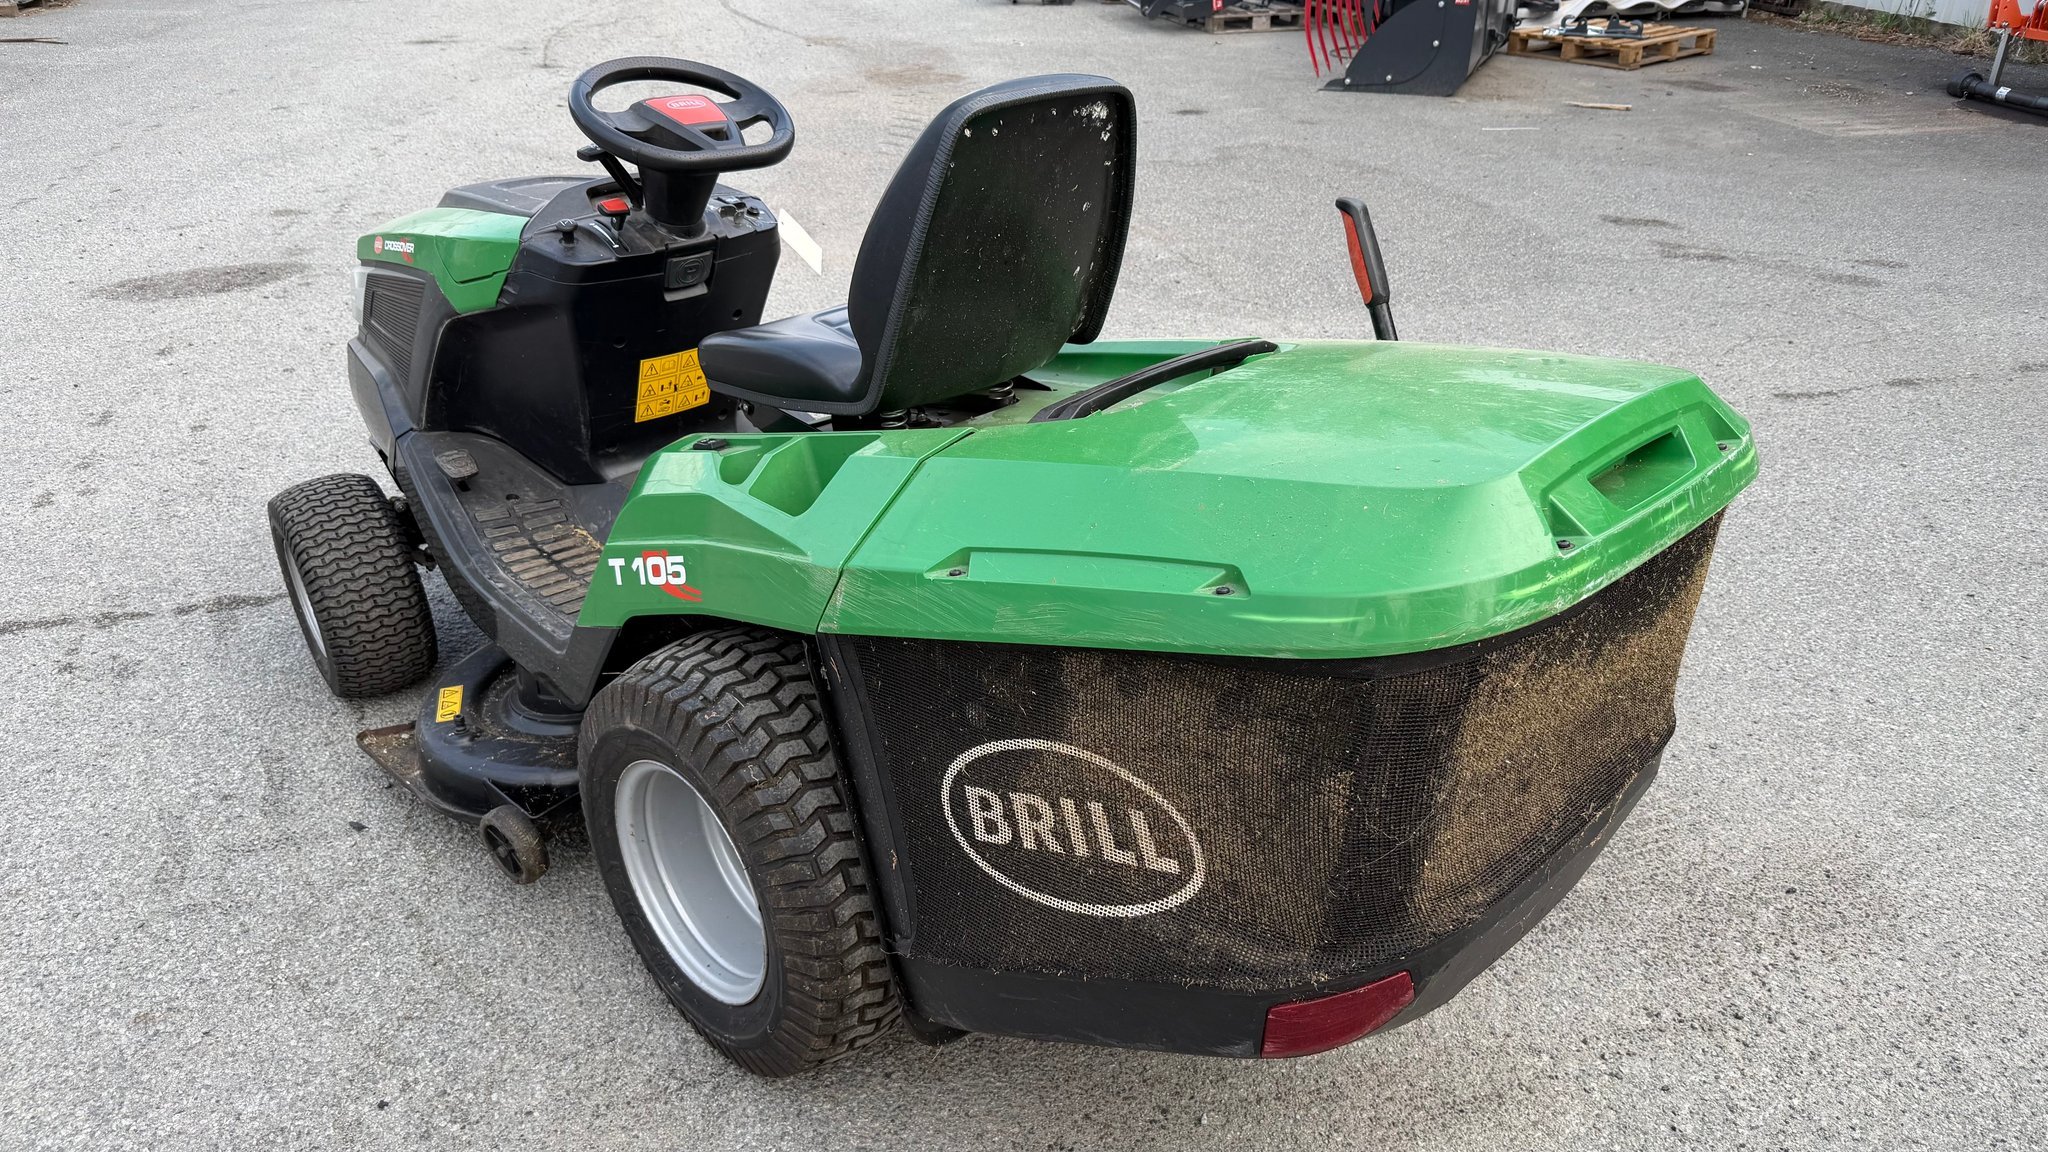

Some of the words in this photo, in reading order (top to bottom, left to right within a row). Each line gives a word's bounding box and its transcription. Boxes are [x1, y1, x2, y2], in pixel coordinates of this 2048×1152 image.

[671, 100, 702, 108] BRILL
[608, 558, 625, 585] T
[631, 555, 686, 585] 105
[964, 785, 1181, 875] BRILL
